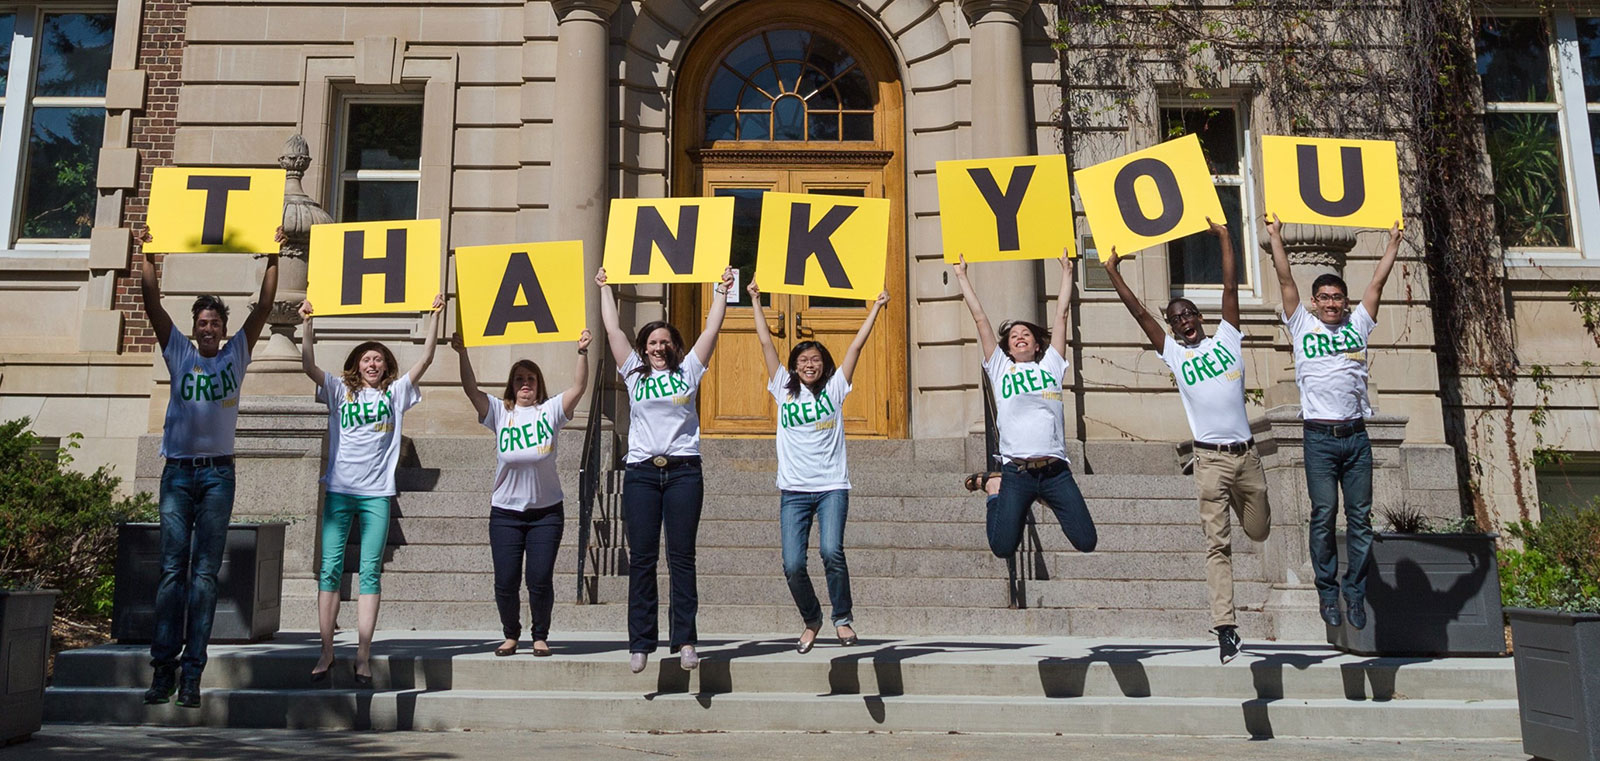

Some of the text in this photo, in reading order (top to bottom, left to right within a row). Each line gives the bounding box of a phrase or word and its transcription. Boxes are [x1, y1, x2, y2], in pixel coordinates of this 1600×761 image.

[187, 176, 250, 244] T
[968, 165, 1036, 251] Y
[1114, 158, 1184, 236] O
[1297, 145, 1365, 218] U
[341, 229, 407, 305] H
[630, 206, 699, 275] N
[785, 203, 858, 290] K
[483, 253, 558, 336] A
[1182, 341, 1237, 386] GREAT
[1303, 322, 1364, 358] GREAT
[181, 362, 237, 402] GREAT
[781, 388, 835, 428] GREAT
[1002, 368, 1058, 399] GREA
